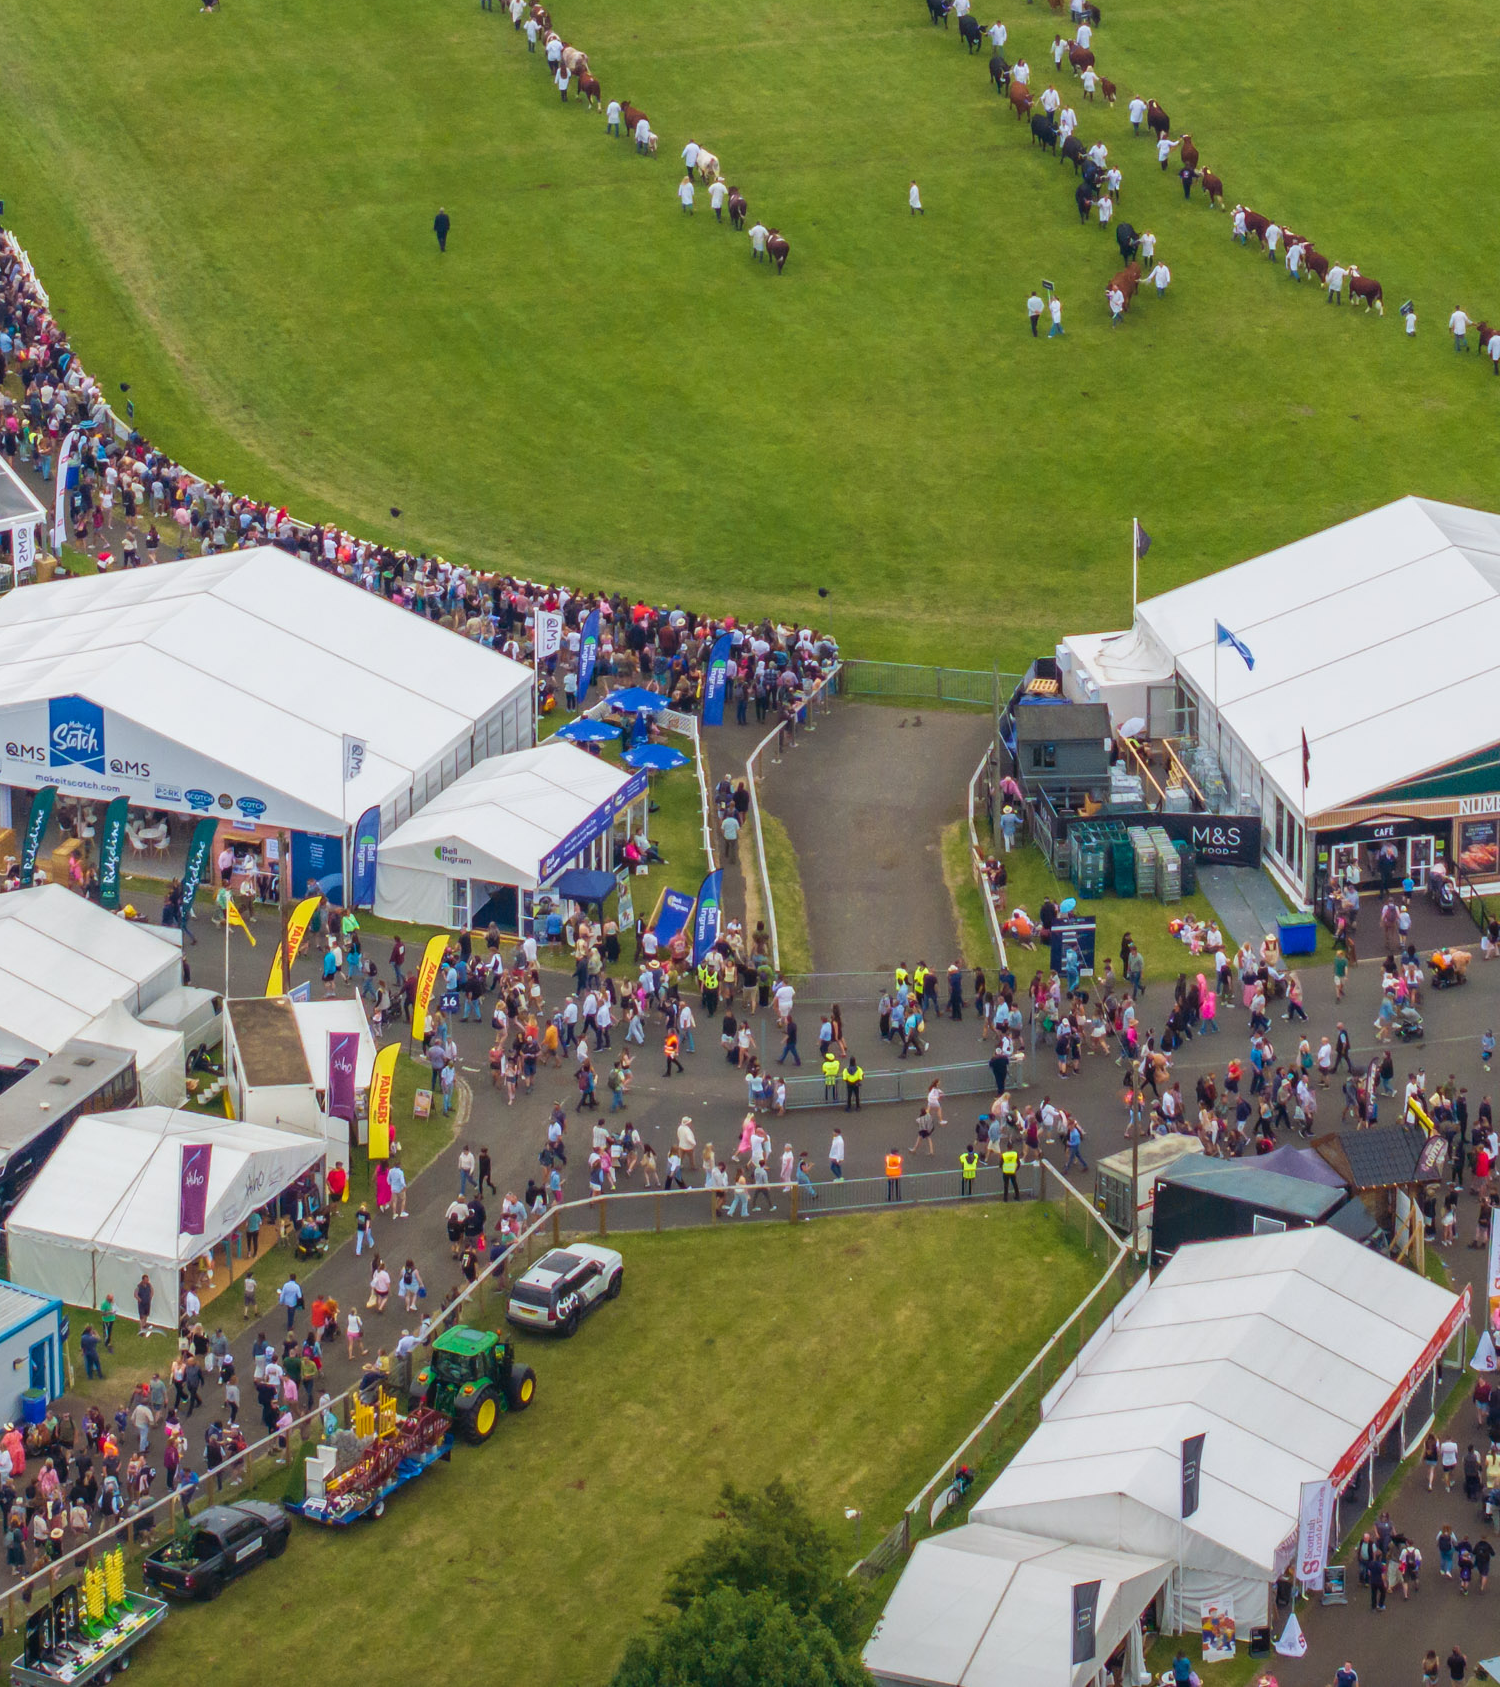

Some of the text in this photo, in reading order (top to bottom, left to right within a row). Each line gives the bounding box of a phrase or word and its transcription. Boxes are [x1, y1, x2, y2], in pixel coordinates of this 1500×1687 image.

[546, 618, 559, 650] QMS
[708, 667, 716, 699] Ingram
[717, 667, 725, 684] Bell
[52, 722, 99, 753] Scotch
[5, 741, 46, 762] QMS
[110, 758, 150, 778] QMS
[35, 773, 120, 794] makeitscotch.com
[185, 791, 214, 804] SCOTCH
[237, 798, 266, 811] SCOTCH
[24, 809, 45, 871] Ridgeline
[1192, 826, 1241, 846] M&S
[1374, 825, 1394, 837] CAFÉ
[103, 820, 120, 884] Ridgeline
[358, 843, 366, 877] Ingram
[366, 843, 375, 862] Bell
[442, 846, 458, 856] Bell
[442, 854, 472, 865] Ingram
[1202, 847, 1229, 855] FOOD
[183, 840, 206, 905] Ridgeline
[698, 906, 706, 941] Ingram
[708, 906, 717, 926] Bell
[420, 961, 437, 1010] FARMERS
[442, 996, 457, 1007] 16
[377, 1075, 391, 1125] FARMERS
[1426, 1138, 1444, 1167] COFFEE
[1306, 1518, 1316, 1552] Scottish
